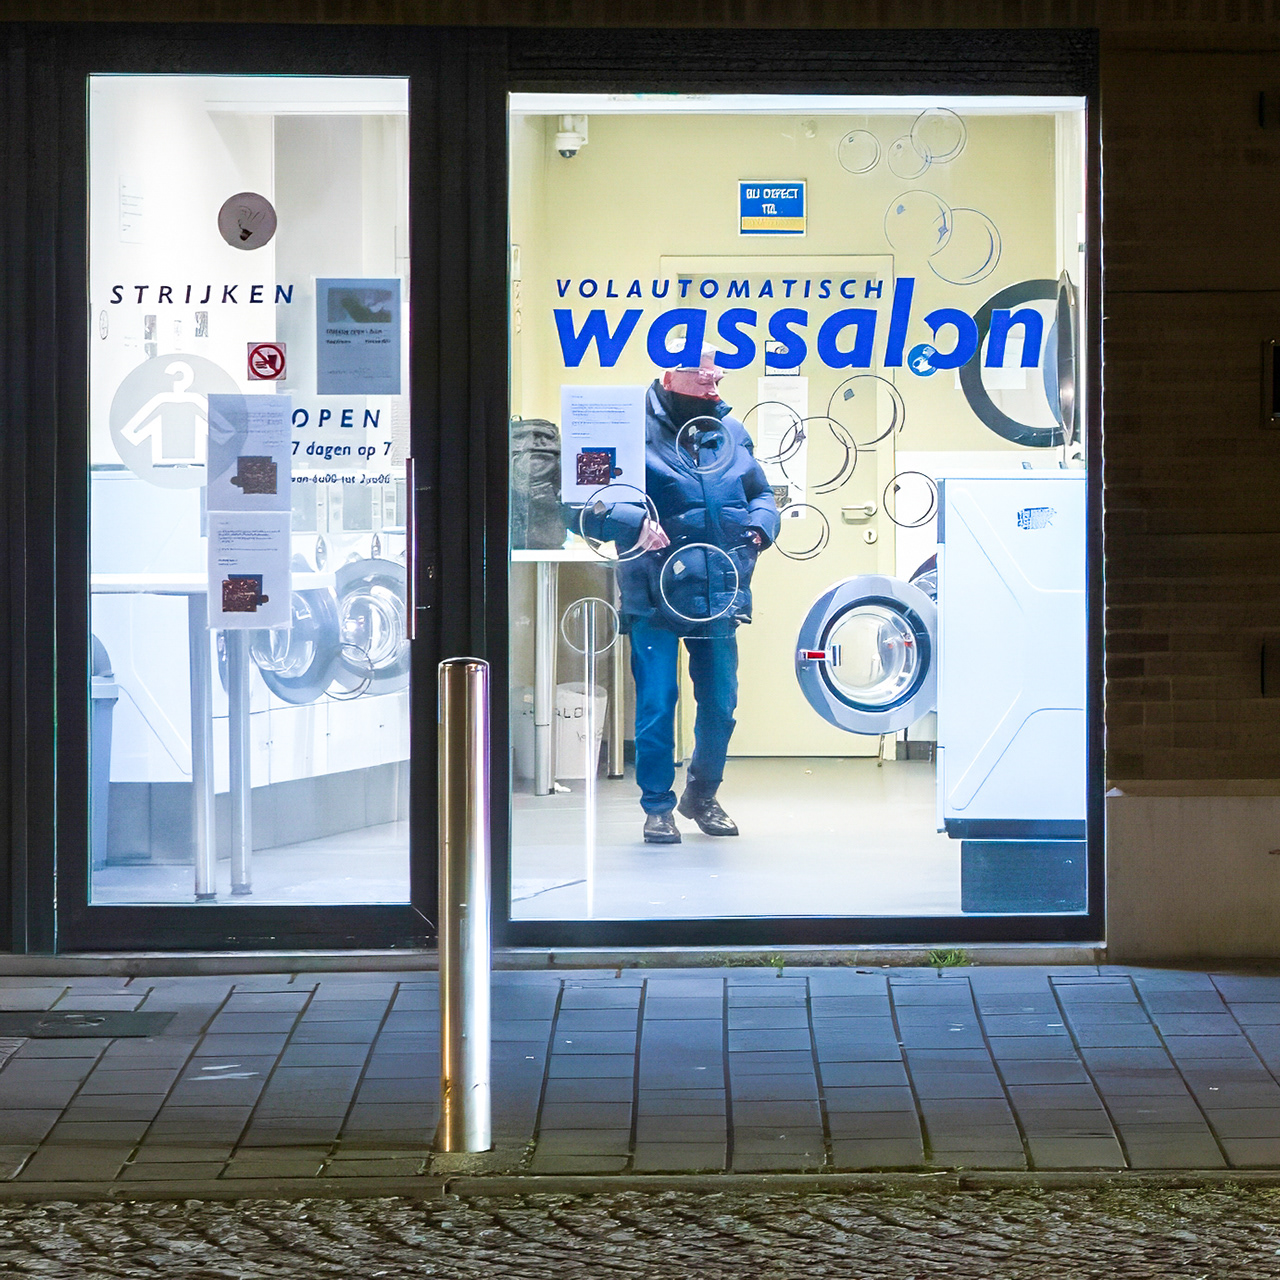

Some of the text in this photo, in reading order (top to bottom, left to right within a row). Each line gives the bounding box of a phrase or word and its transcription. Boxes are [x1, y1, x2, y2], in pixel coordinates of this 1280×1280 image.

[110, 284, 294, 305] STRIJKEN
[557, 279, 884, 299] VOLAUTOMATISCH
[553, 277, 1044, 370] wassalon
[291, 408, 381, 428] OPEN
[291, 441, 392, 460] 7 dagen op 7
